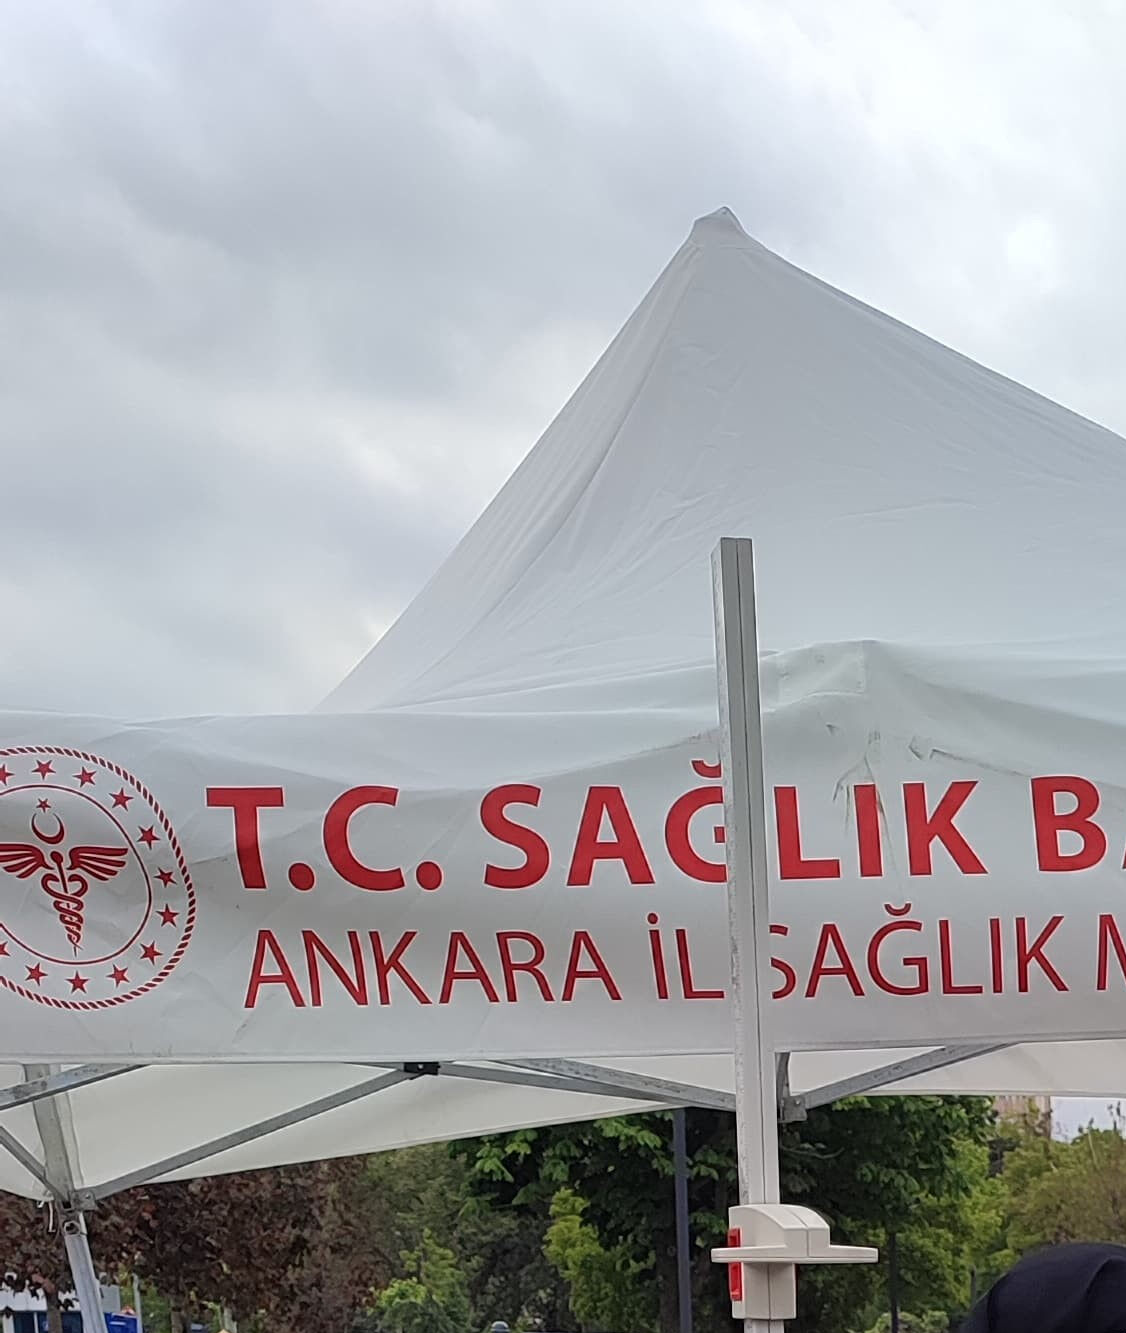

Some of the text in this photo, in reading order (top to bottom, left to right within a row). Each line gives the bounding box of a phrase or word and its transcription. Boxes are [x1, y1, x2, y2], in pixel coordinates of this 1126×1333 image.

[206, 785, 444, 892] T.C.
[479, 759, 989, 891] SAĞLIK
[244, 929, 622, 1009] ANKARA
[647, 913, 725, 1000] İL
[769, 902, 1069, 1001] SAĞLIK
